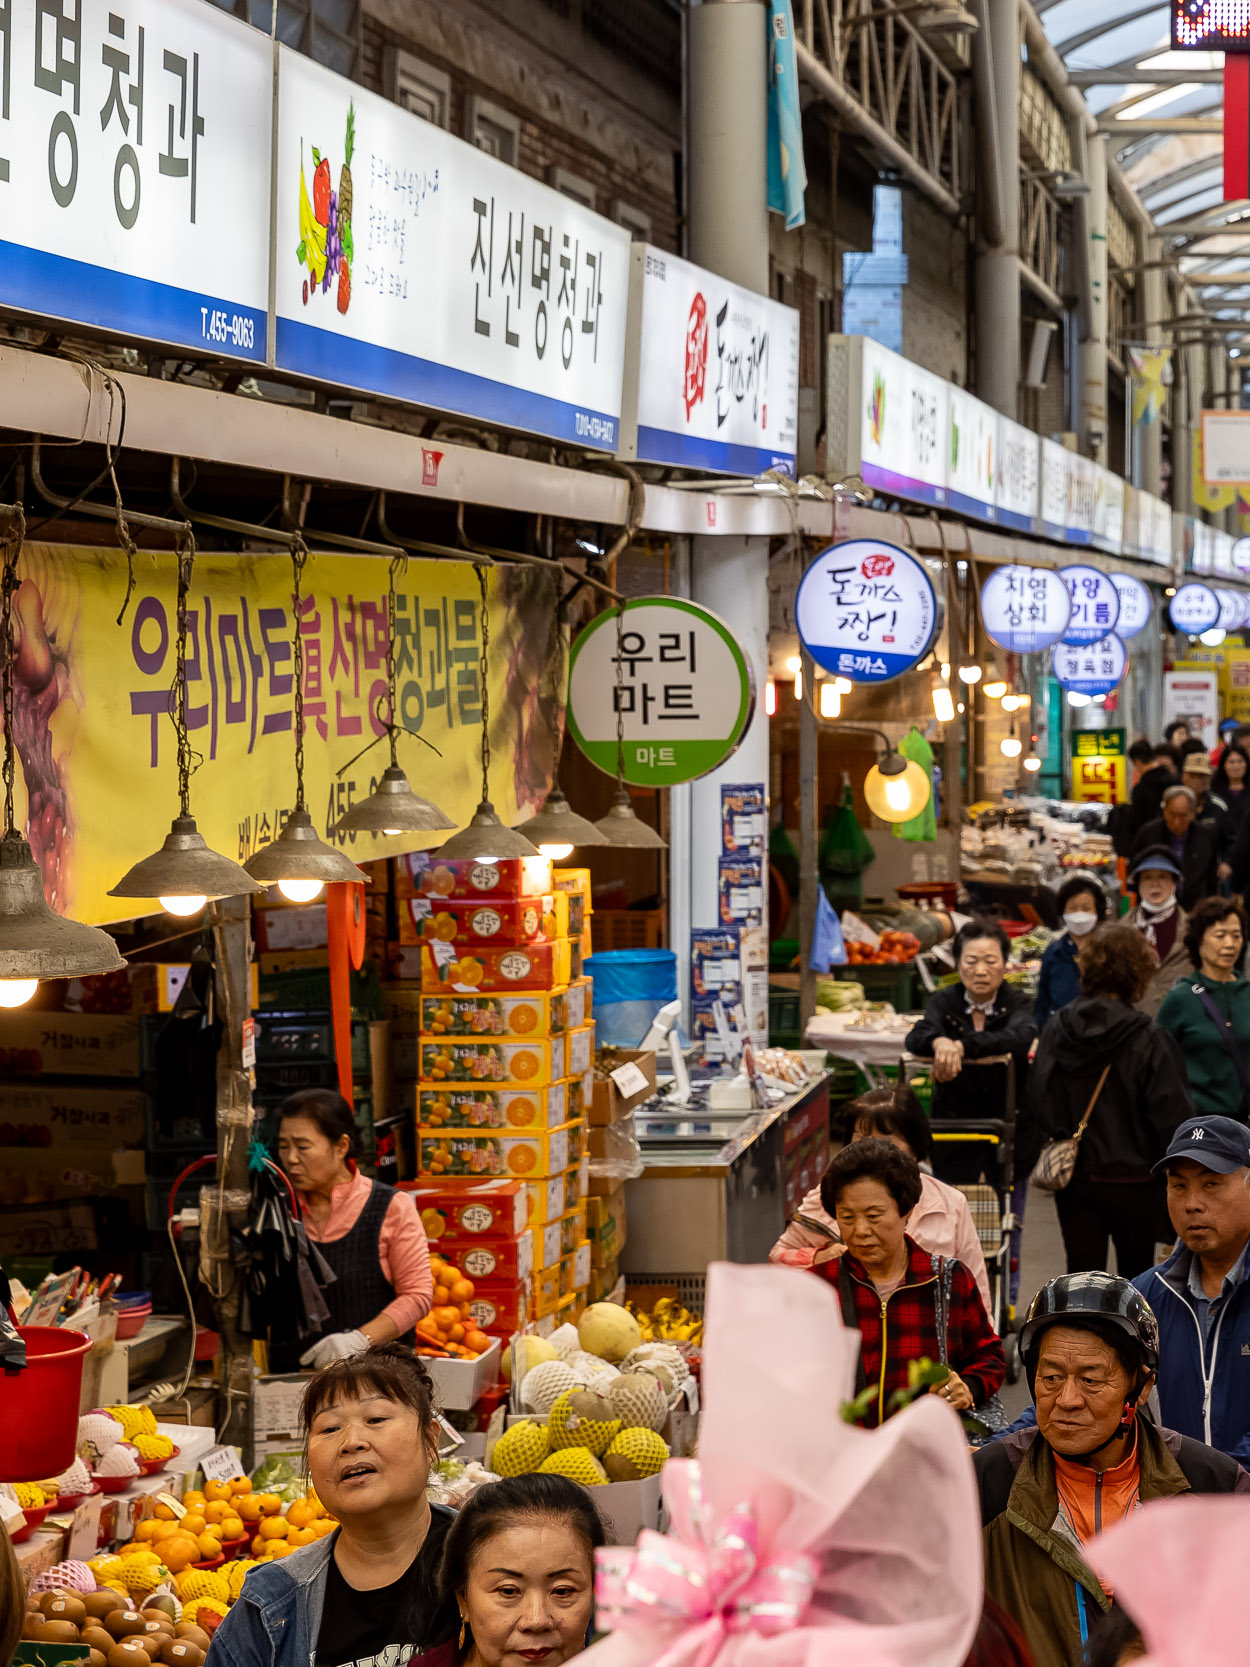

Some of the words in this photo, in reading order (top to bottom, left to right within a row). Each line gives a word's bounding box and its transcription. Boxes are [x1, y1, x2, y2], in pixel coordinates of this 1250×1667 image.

[0, 0, 205, 230] 명청과
[470, 196, 604, 371] 진선명청과
[200, 306, 254, 349] T.455-9063
[826, 566, 904, 606] 돈까스
[1070, 577, 1101, 599] 양
[838, 610, 898, 641] 짱!
[1004, 603, 1047, 626] 상회
[611, 631, 698, 678] 우리
[837, 653, 888, 675] 돈까스
[612, 684, 700, 725] 마트
[636, 746, 676, 768] 마트
